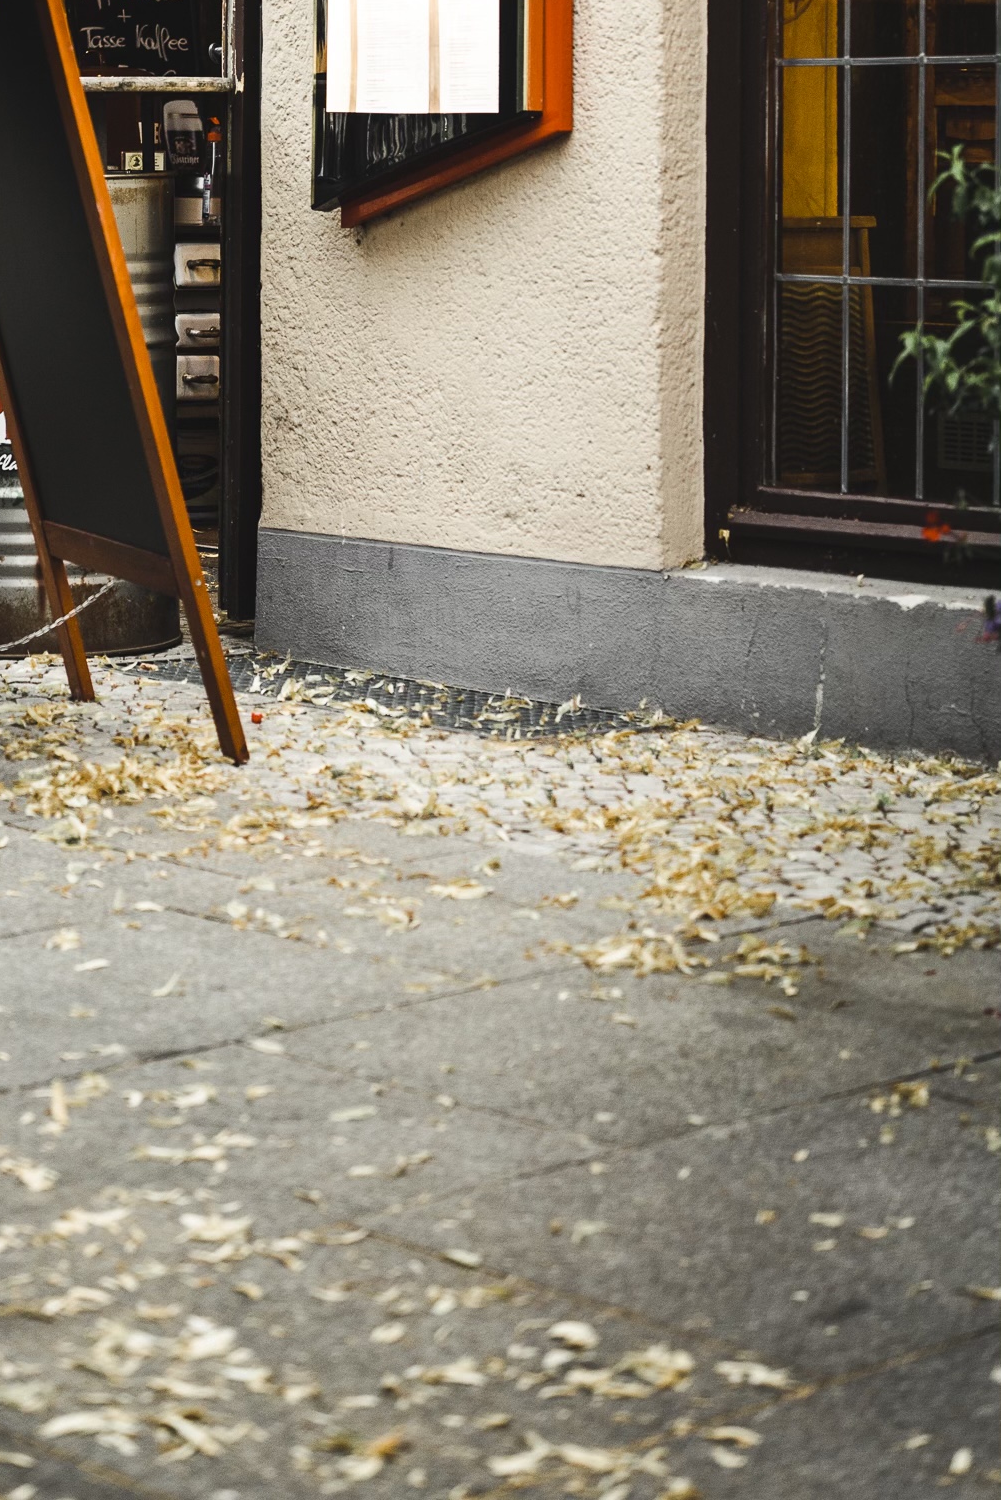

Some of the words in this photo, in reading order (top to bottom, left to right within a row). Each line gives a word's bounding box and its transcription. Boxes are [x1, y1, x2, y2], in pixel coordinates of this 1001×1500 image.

[117, 9, 132, 23] +
[80, 26, 126, 49] Tasse
[136, 23, 189, 62] Kaffee
